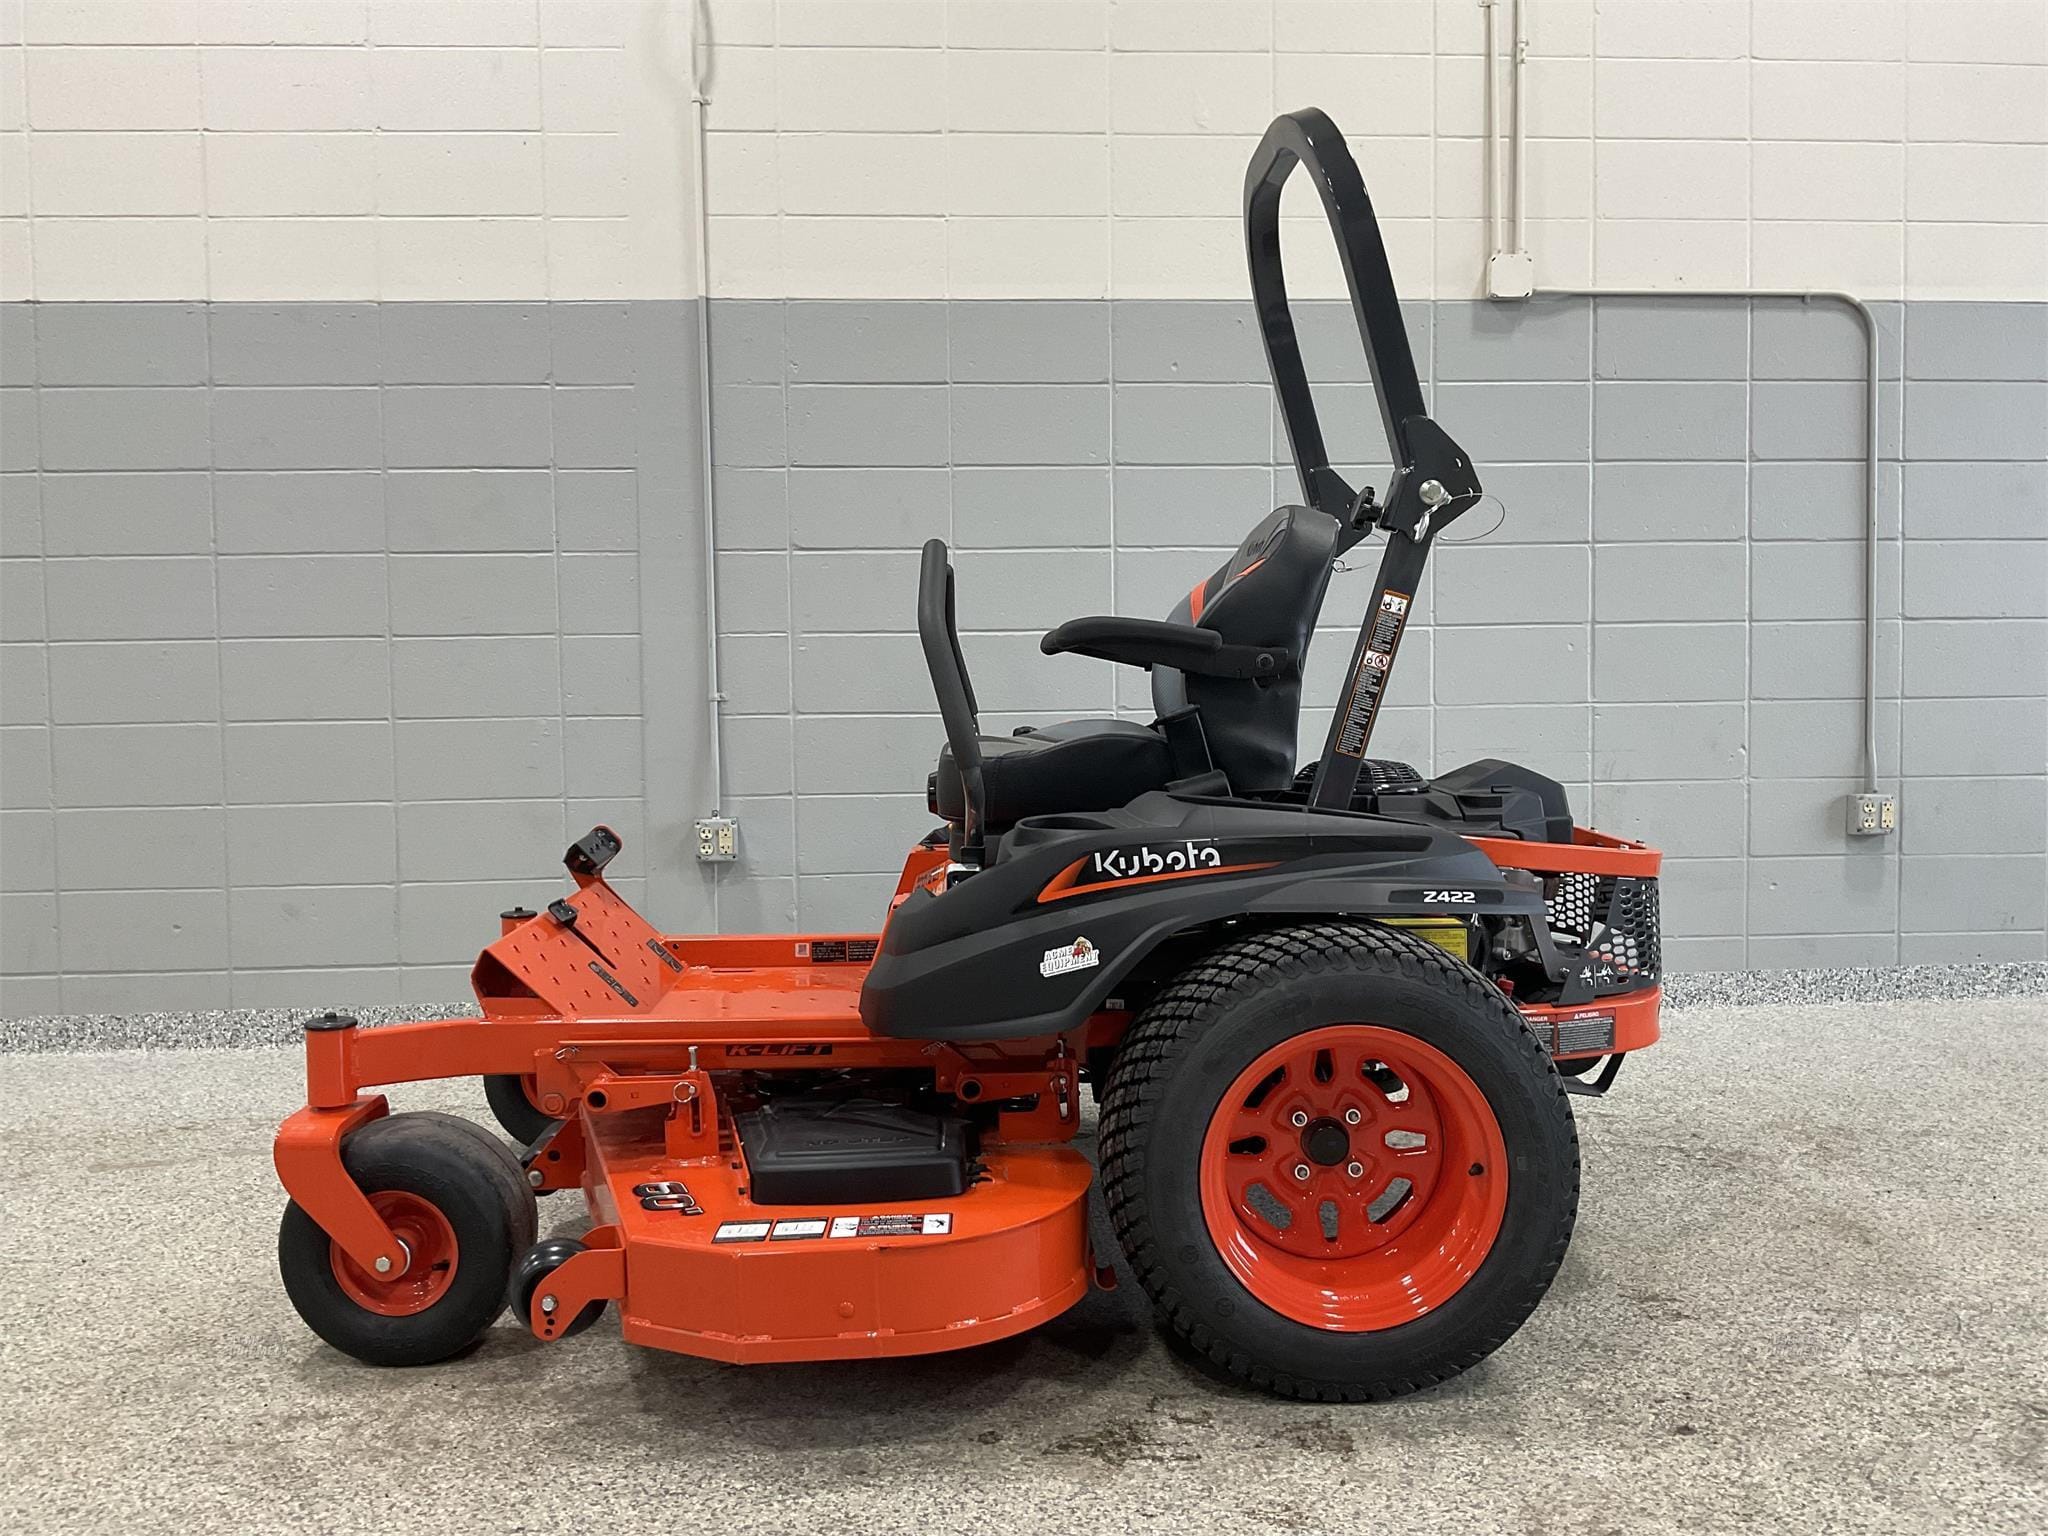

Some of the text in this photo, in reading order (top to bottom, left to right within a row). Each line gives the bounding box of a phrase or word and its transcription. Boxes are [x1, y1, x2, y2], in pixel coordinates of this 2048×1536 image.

[1094, 841, 1221, 877] Kubota
[1423, 890, 1476, 904] Z422
[1044, 946, 1073, 961] ACME
[1041, 950, 1099, 973] EQUIPMENT
[728, 1044, 830, 1056] K-LIFT
